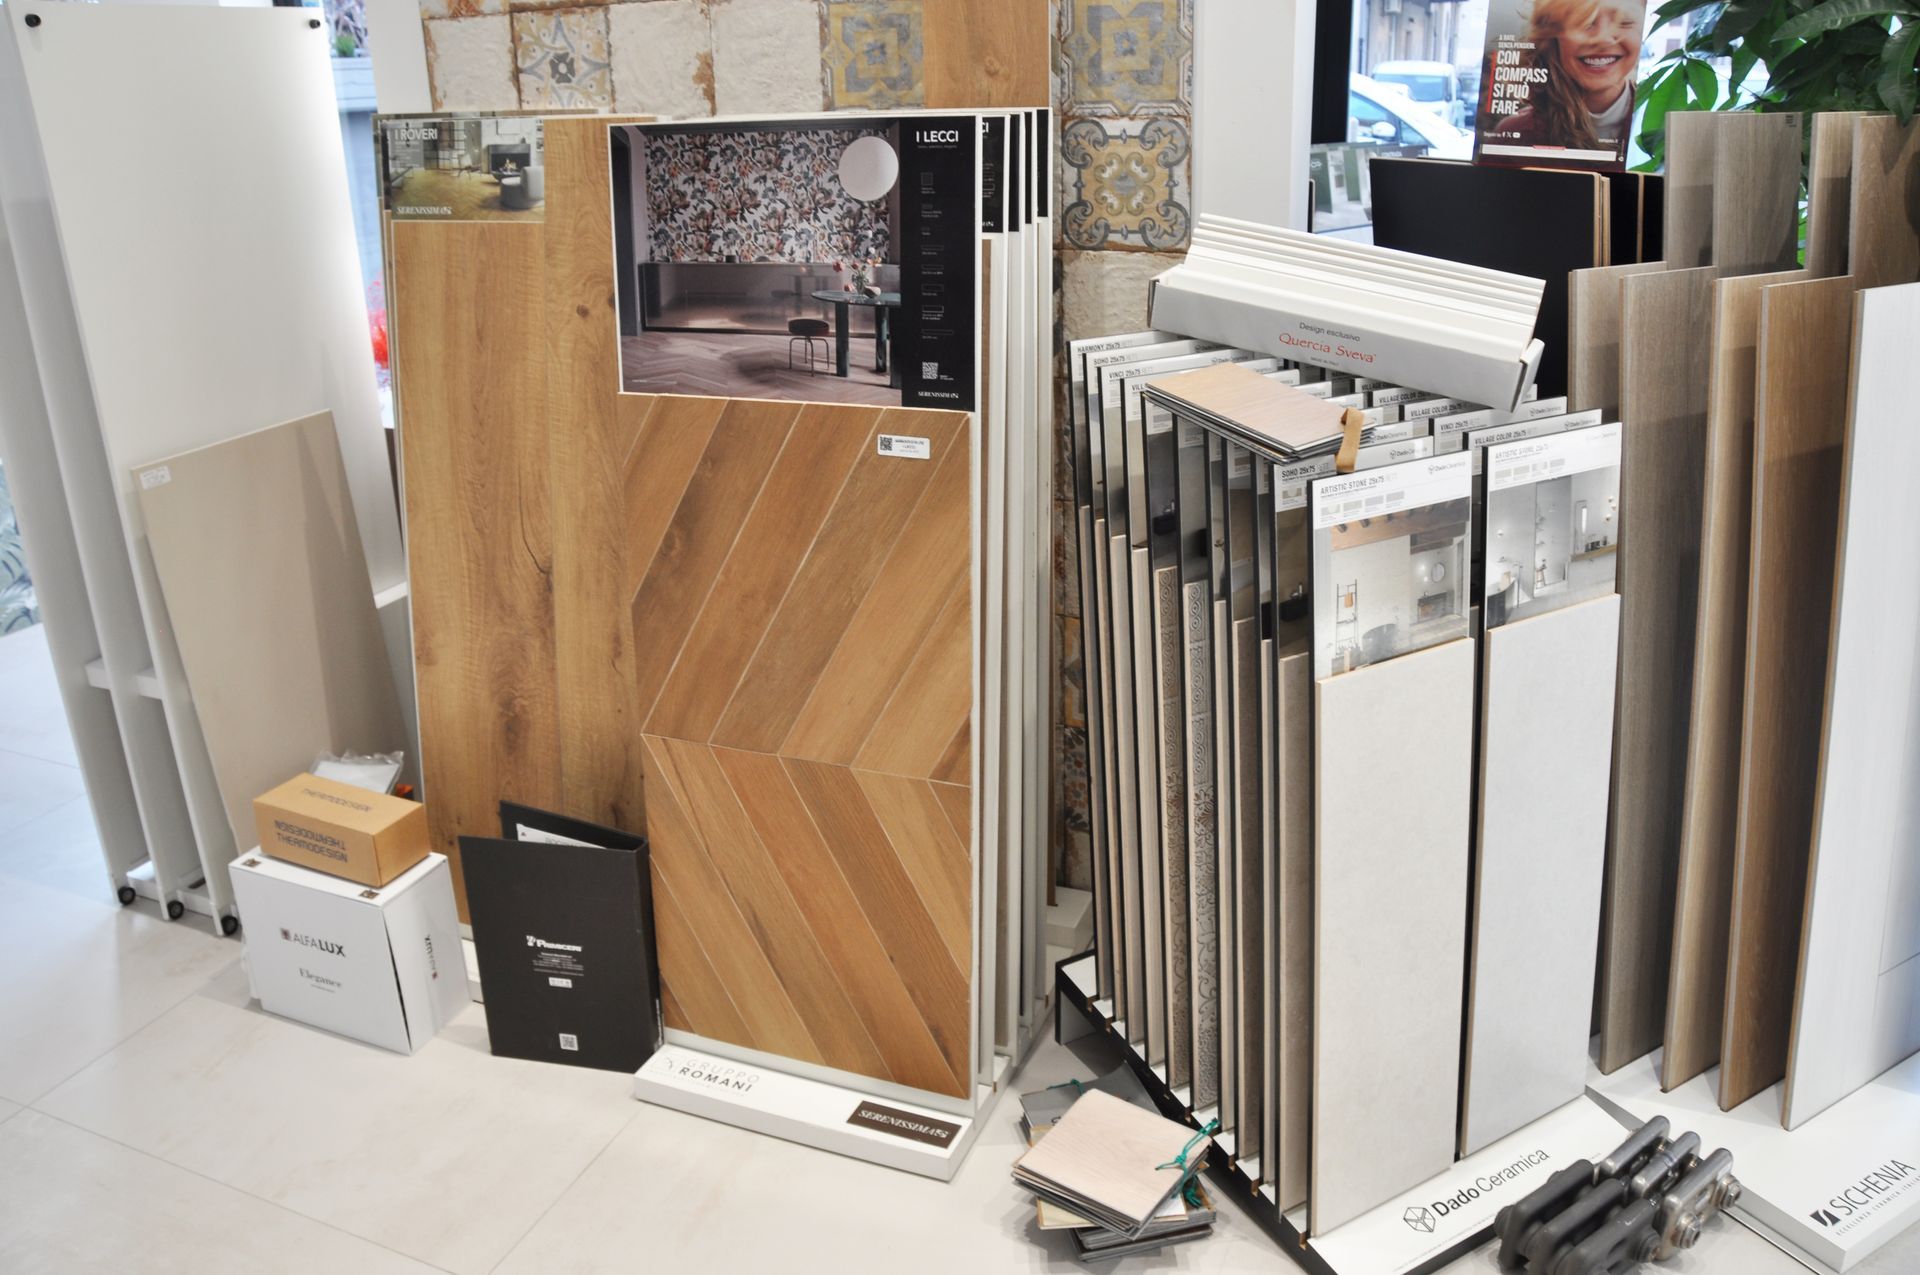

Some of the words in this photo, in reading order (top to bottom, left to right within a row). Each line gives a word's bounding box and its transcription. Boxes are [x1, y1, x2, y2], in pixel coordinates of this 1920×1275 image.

[1496, 50, 1520, 66] CON
[1494, 67, 1548, 83] COMPASS
[1492, 83, 1504, 98] SI
[1506, 81, 1530, 99] PUÒ
[1490, 99, 1520, 116] FARE
[400, 128, 438, 140] ROVERI
[916, 131, 920, 143] I
[923, 130, 959, 143] LECCI
[1299, 321, 1325, 335] Design
[1326, 329, 1361, 342] esclusivo
[1278, 332, 1331, 353] Quercia
[1335, 345, 1374, 364] Sveva
[1093, 357, 1109, 366] SOHO
[1109, 370, 1125, 379] VINCI
[1410, 407, 1431, 417] VILLAGE
[1431, 404, 1448, 414] COLOR
[1474, 434, 1496, 445] VILLAGE
[1281, 467, 1298, 479] SOHO
[1299, 464, 1316, 475] 25x75
[1320, 480, 1347, 495] ARTISTIC
[1349, 477, 1368, 490] STONE
[1368, 475, 1385, 486] 25x75
[277, 832, 348, 863] THERMODESIGN
[678, 1066, 753, 1092] ROMANI
[687, 1059, 760, 1084] GRUPPO
[858, 1109, 938, 1137] SERENISSIMA
[1829, 1159, 1917, 1216] SICHENIA
